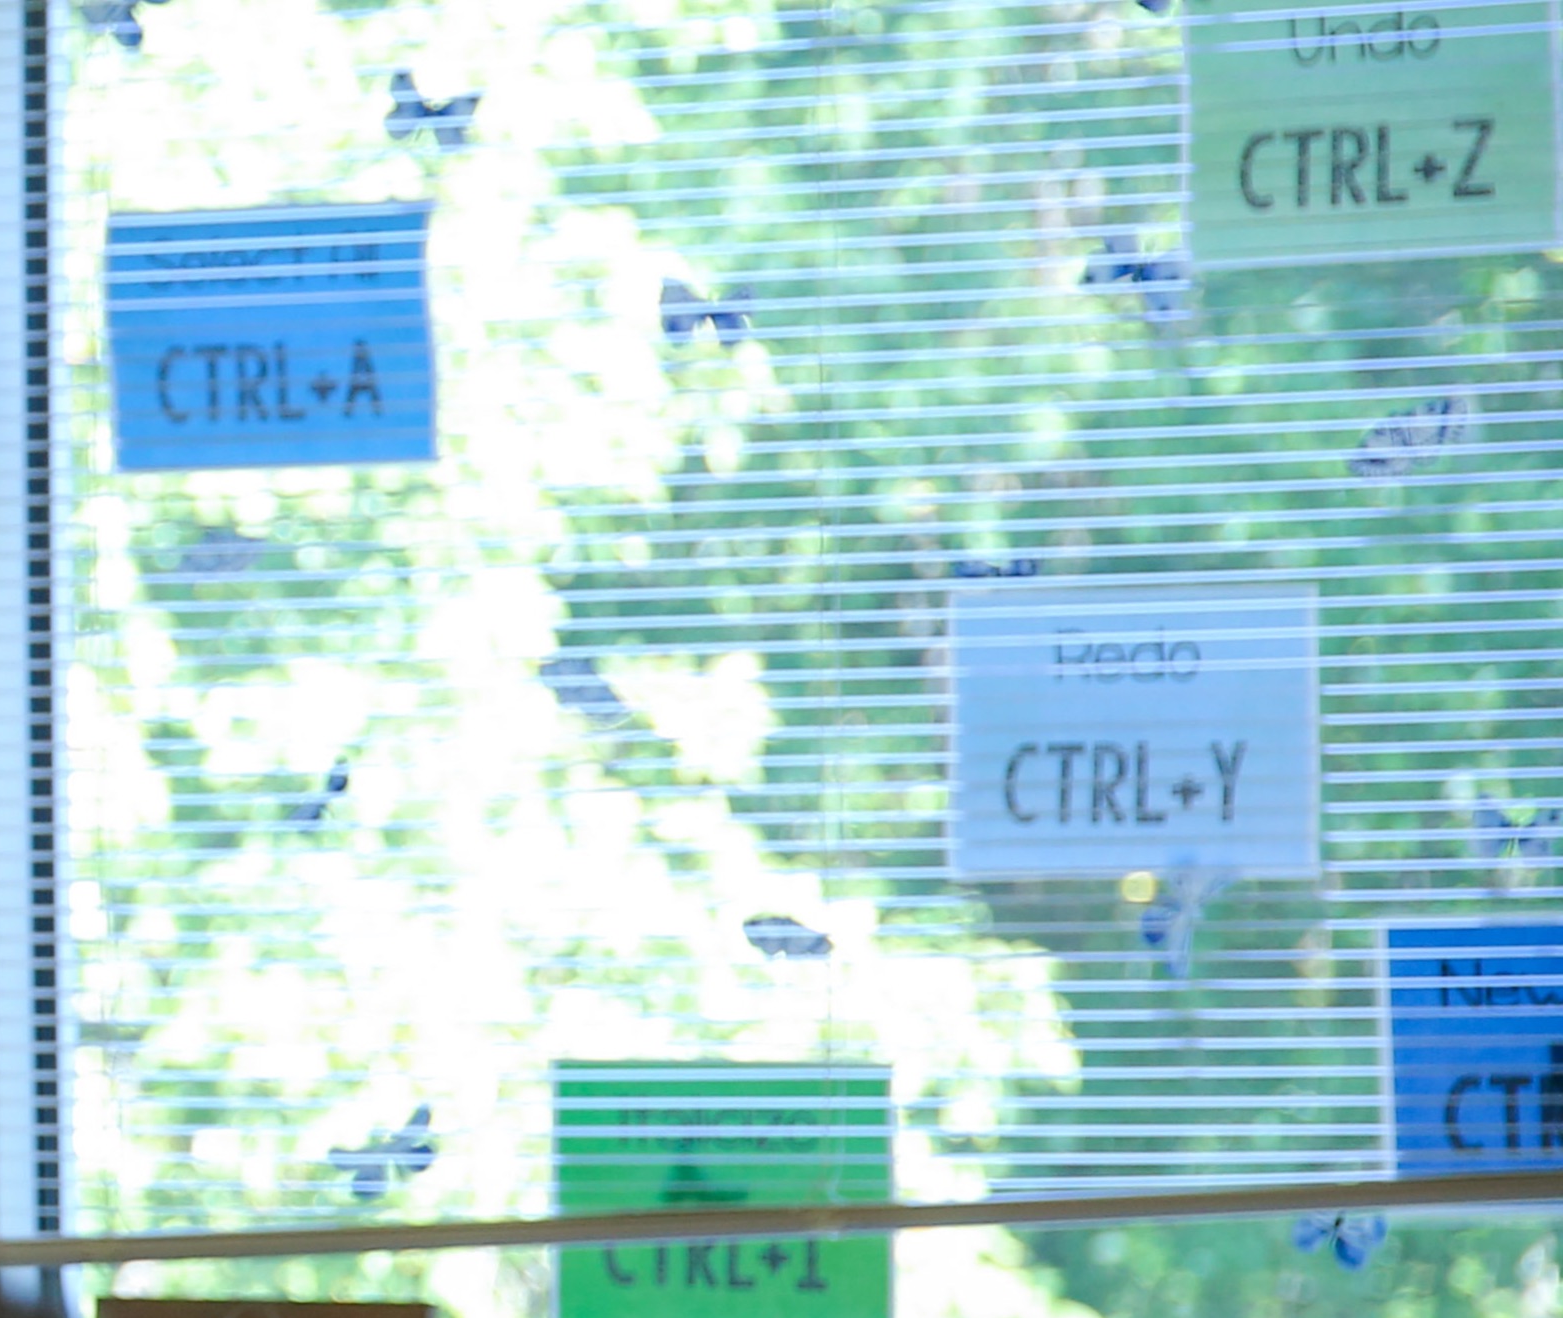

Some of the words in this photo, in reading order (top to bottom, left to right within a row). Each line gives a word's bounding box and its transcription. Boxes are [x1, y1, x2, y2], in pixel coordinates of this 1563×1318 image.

[1288, 11, 1441, 67] Undo
[1239, 115, 1496, 210] CTRL+Z
[155, 338, 384, 426] CTRL+A
[1052, 627, 1203, 683] Redo
[1004, 739, 1248, 824] CTRL+Y
